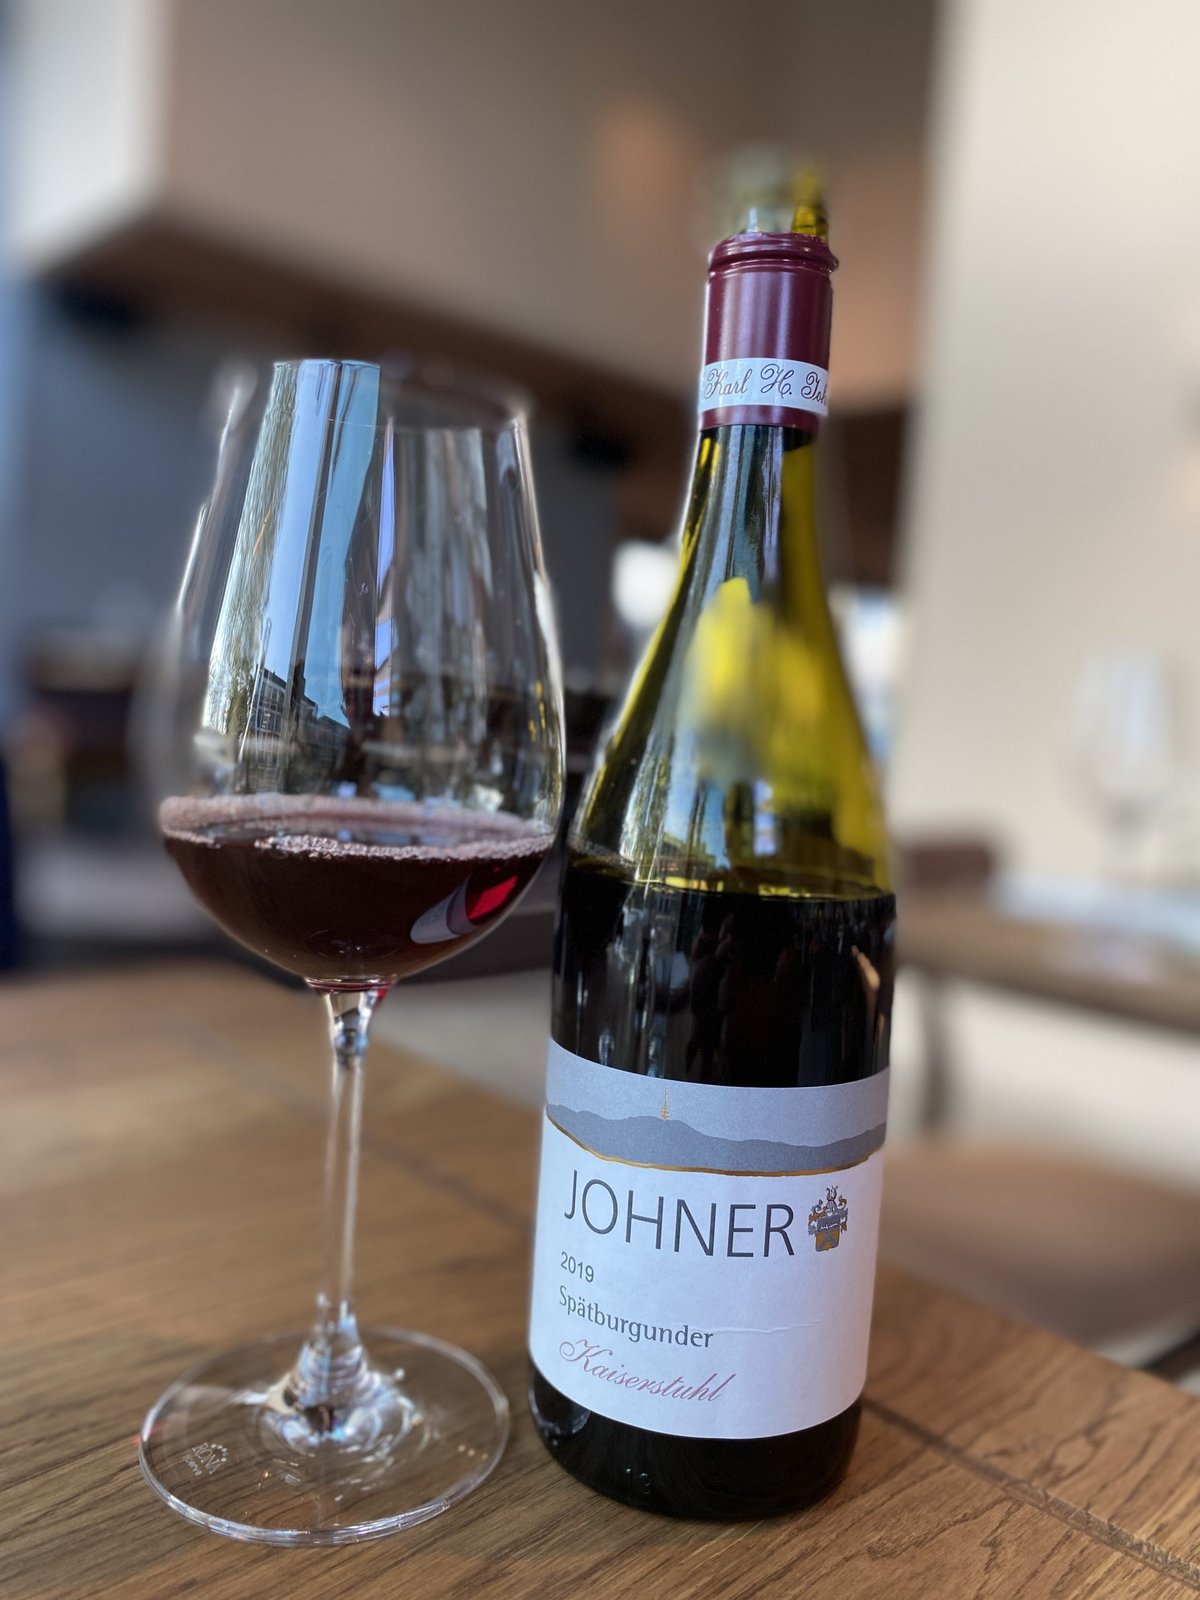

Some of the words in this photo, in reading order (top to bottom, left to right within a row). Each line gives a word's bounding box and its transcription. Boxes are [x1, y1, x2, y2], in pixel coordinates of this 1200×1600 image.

[704, 368, 753, 399] Karl
[760, 363, 794, 399] H.
[564, 1169, 795, 1258] JOHNER
[560, 1251, 595, 1283] 2019
[559, 1285, 714, 1348] Spätburgunder
[559, 1339, 737, 1402] Kaiserstuhl
[192, 1442, 223, 1475] RONA
